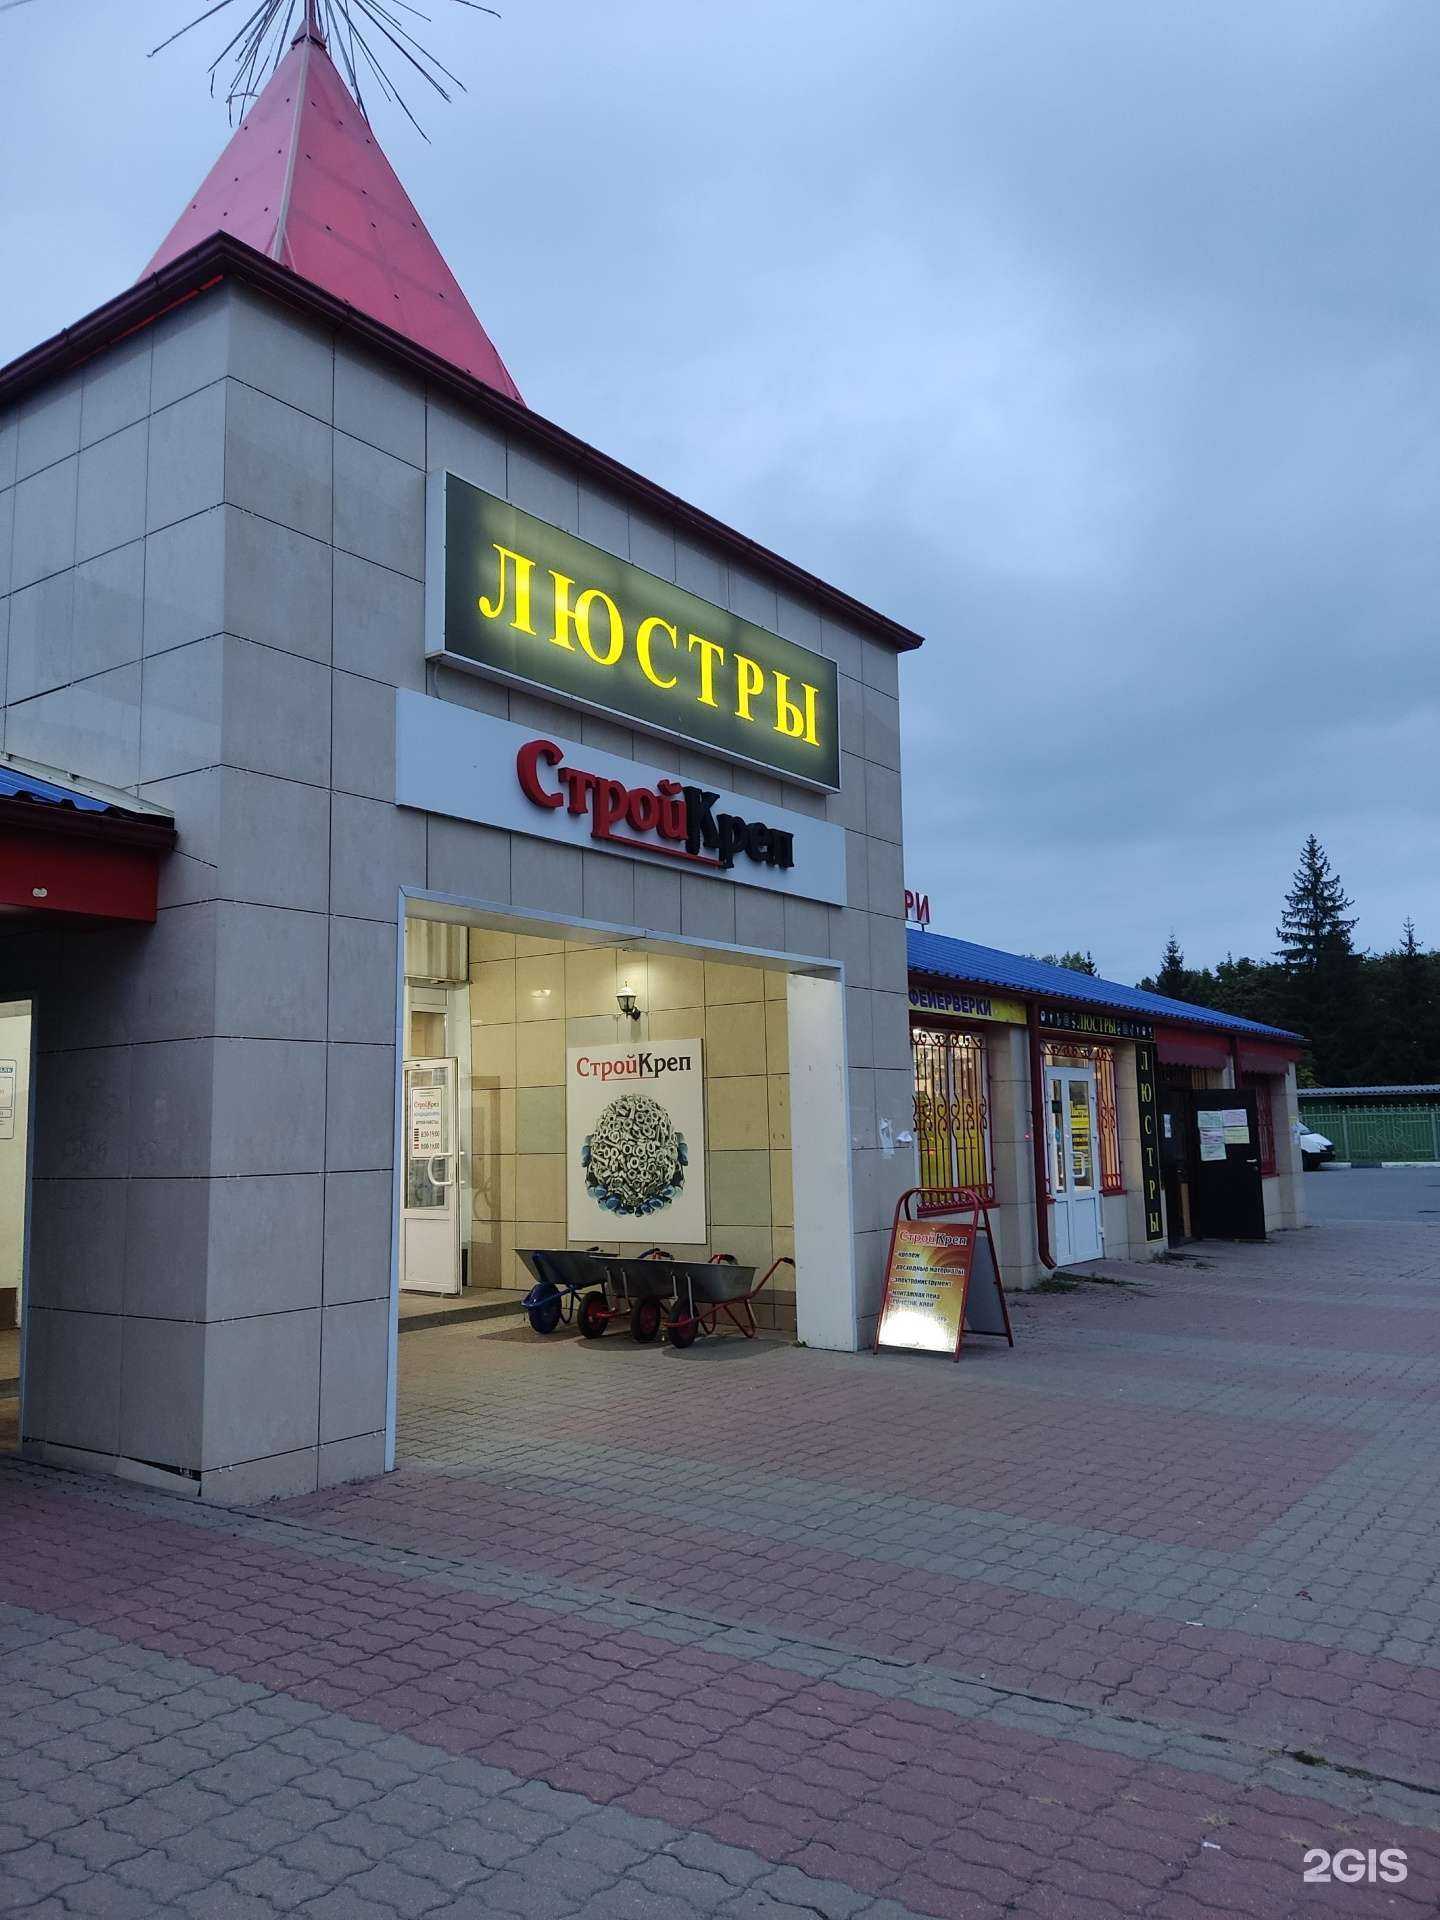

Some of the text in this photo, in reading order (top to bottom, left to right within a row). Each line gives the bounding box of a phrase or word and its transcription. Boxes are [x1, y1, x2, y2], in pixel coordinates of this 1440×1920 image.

[478, 543, 820, 747] ЛЮСТРЫ
[516, 740, 794, 869] СтройКреп
[909, 988, 992, 1017] ФЕЙЕРВЕРКИ
[1078, 1015, 1117, 1034] ЛЮСТРЫ
[576, 1053, 691, 1081] СтройКреп
[1141, 1051, 1159, 1232] ЛЮСТРЫ
[900, 1230, 968, 1247] СтройКреп
